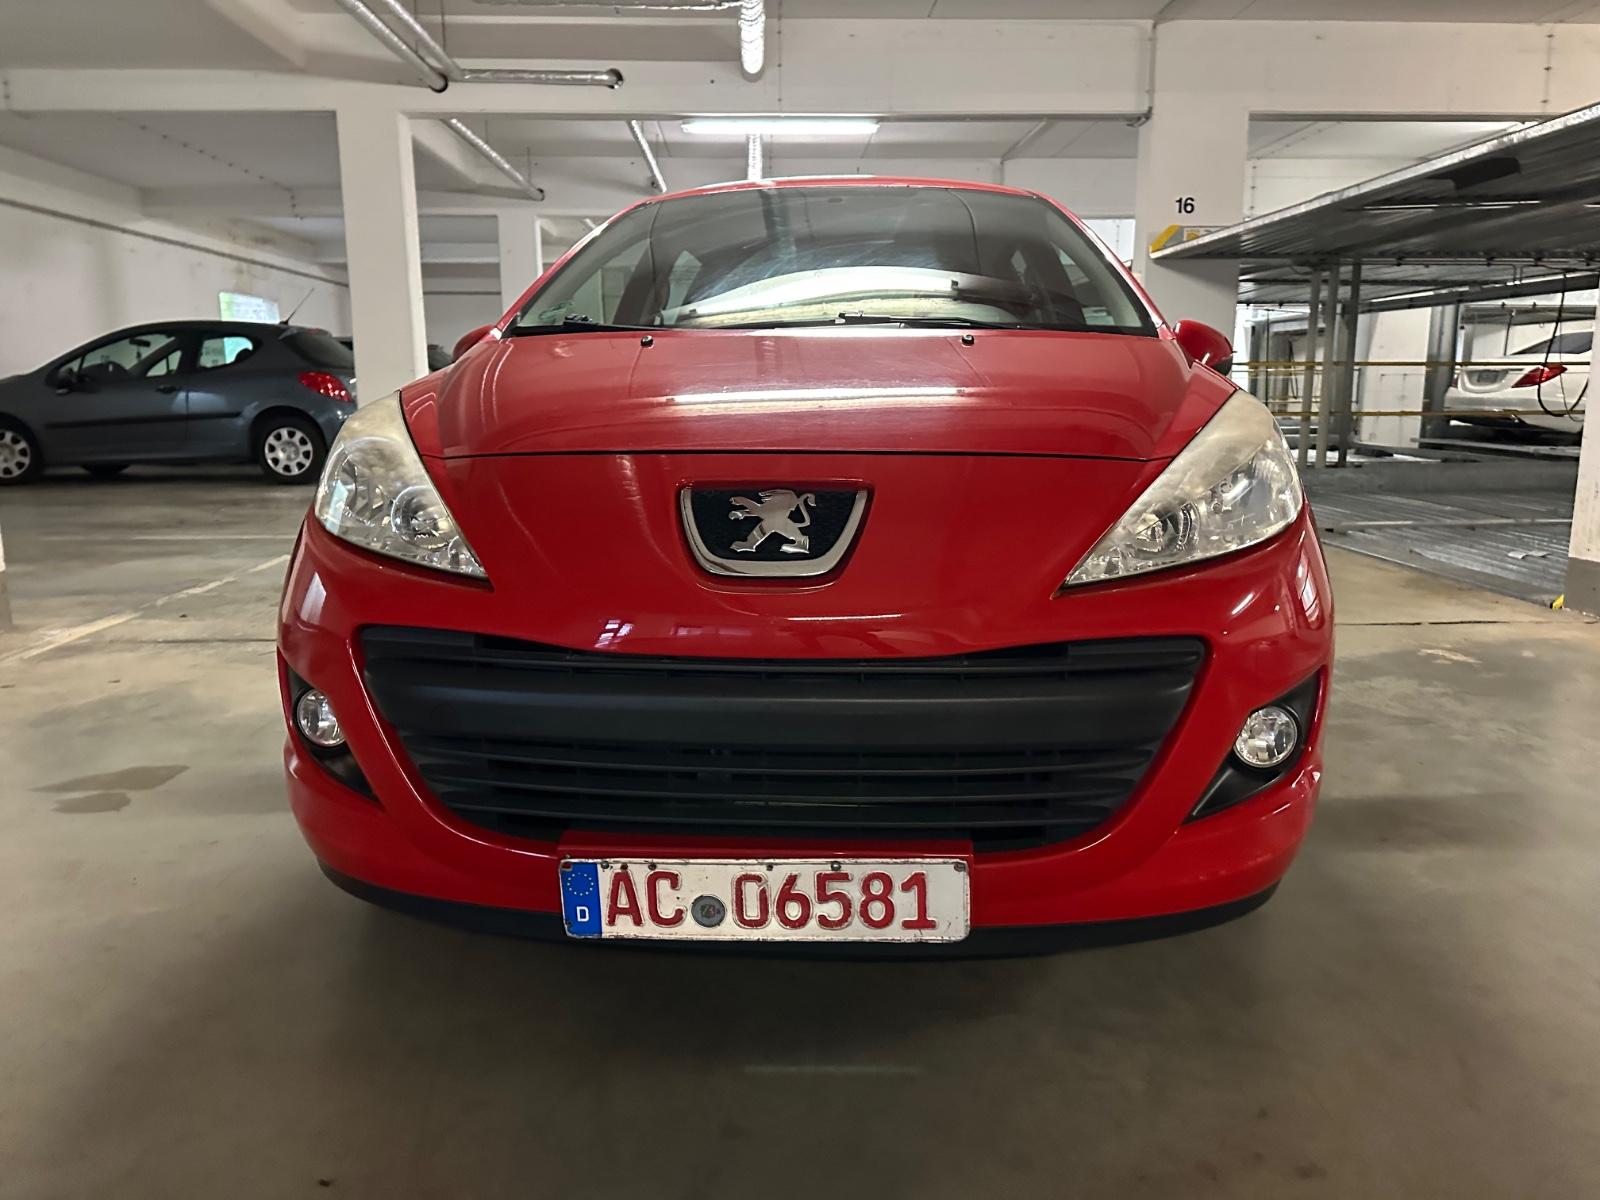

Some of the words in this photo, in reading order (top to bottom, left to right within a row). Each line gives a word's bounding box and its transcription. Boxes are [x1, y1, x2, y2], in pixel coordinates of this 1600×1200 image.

[1175, 197, 1195, 214] 16
[606, 870, 686, 927] AC
[734, 871, 937, 930] 06581
[576, 906, 589, 922] D
